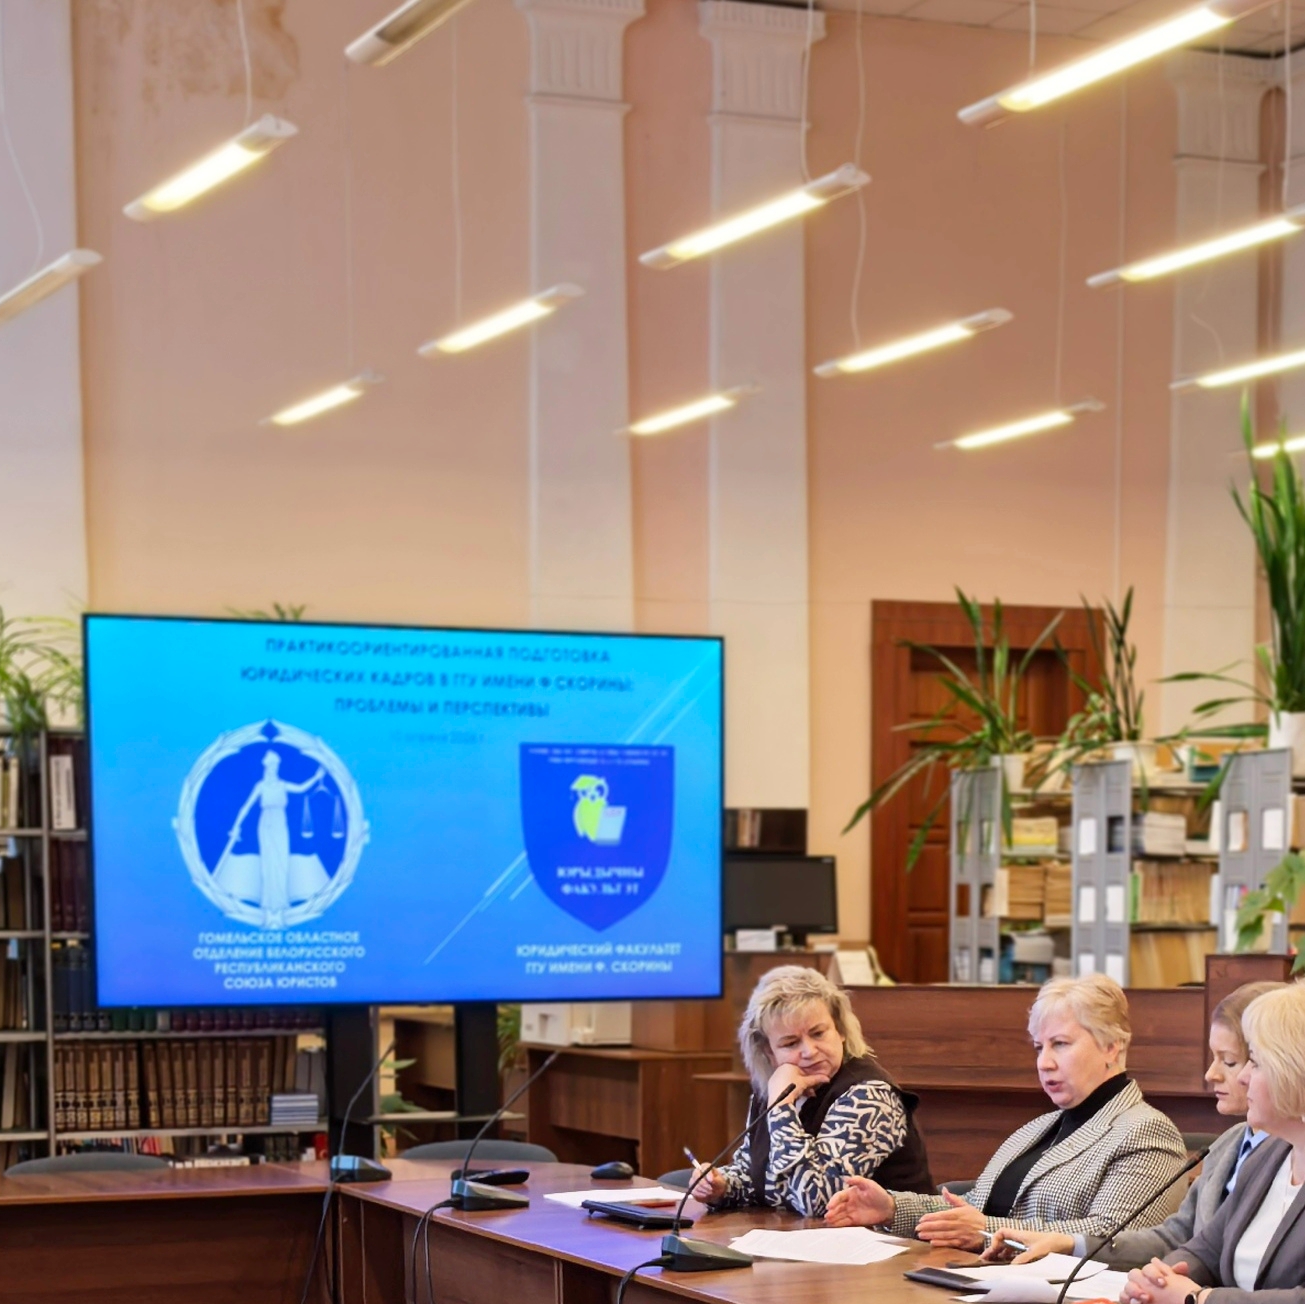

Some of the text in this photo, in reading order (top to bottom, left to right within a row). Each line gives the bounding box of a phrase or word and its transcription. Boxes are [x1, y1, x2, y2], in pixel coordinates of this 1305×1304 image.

[265, 638, 611, 663] ПРАКТИКООРИЕНТИРОВАННАЯ ПОДГОТОВКА
[241, 666, 366, 684] ЮРИДИЧЕСКИХ
[370, 670, 436, 686] КАДРОВ
[440, 673, 449, 687] В
[482, 674, 536, 689] ИМЕНИ
[334, 697, 550, 718] ПРОБЛЕМЫ И ПЕРСПЕКТИВЫ
[198, 931, 360, 944] ГОМЕЛЬСКОЕ ОБЛАСТНОЕ
[192, 945, 366, 960] ОТДЕЛЕНИЕ БЕЛОРУССКОГО
[516, 941, 682, 958] ЮРИДИЧЕСКИЙ ФАКУЛЬТЕТ
[214, 961, 347, 974] РЕСПУБЛИКАНСКОГО
[548, 961, 593, 974] ИМЕНИ
[611, 960, 673, 973] СКОРИНЫ
[223, 975, 338, 989] СОЮЗА ЮРИСТОВ
